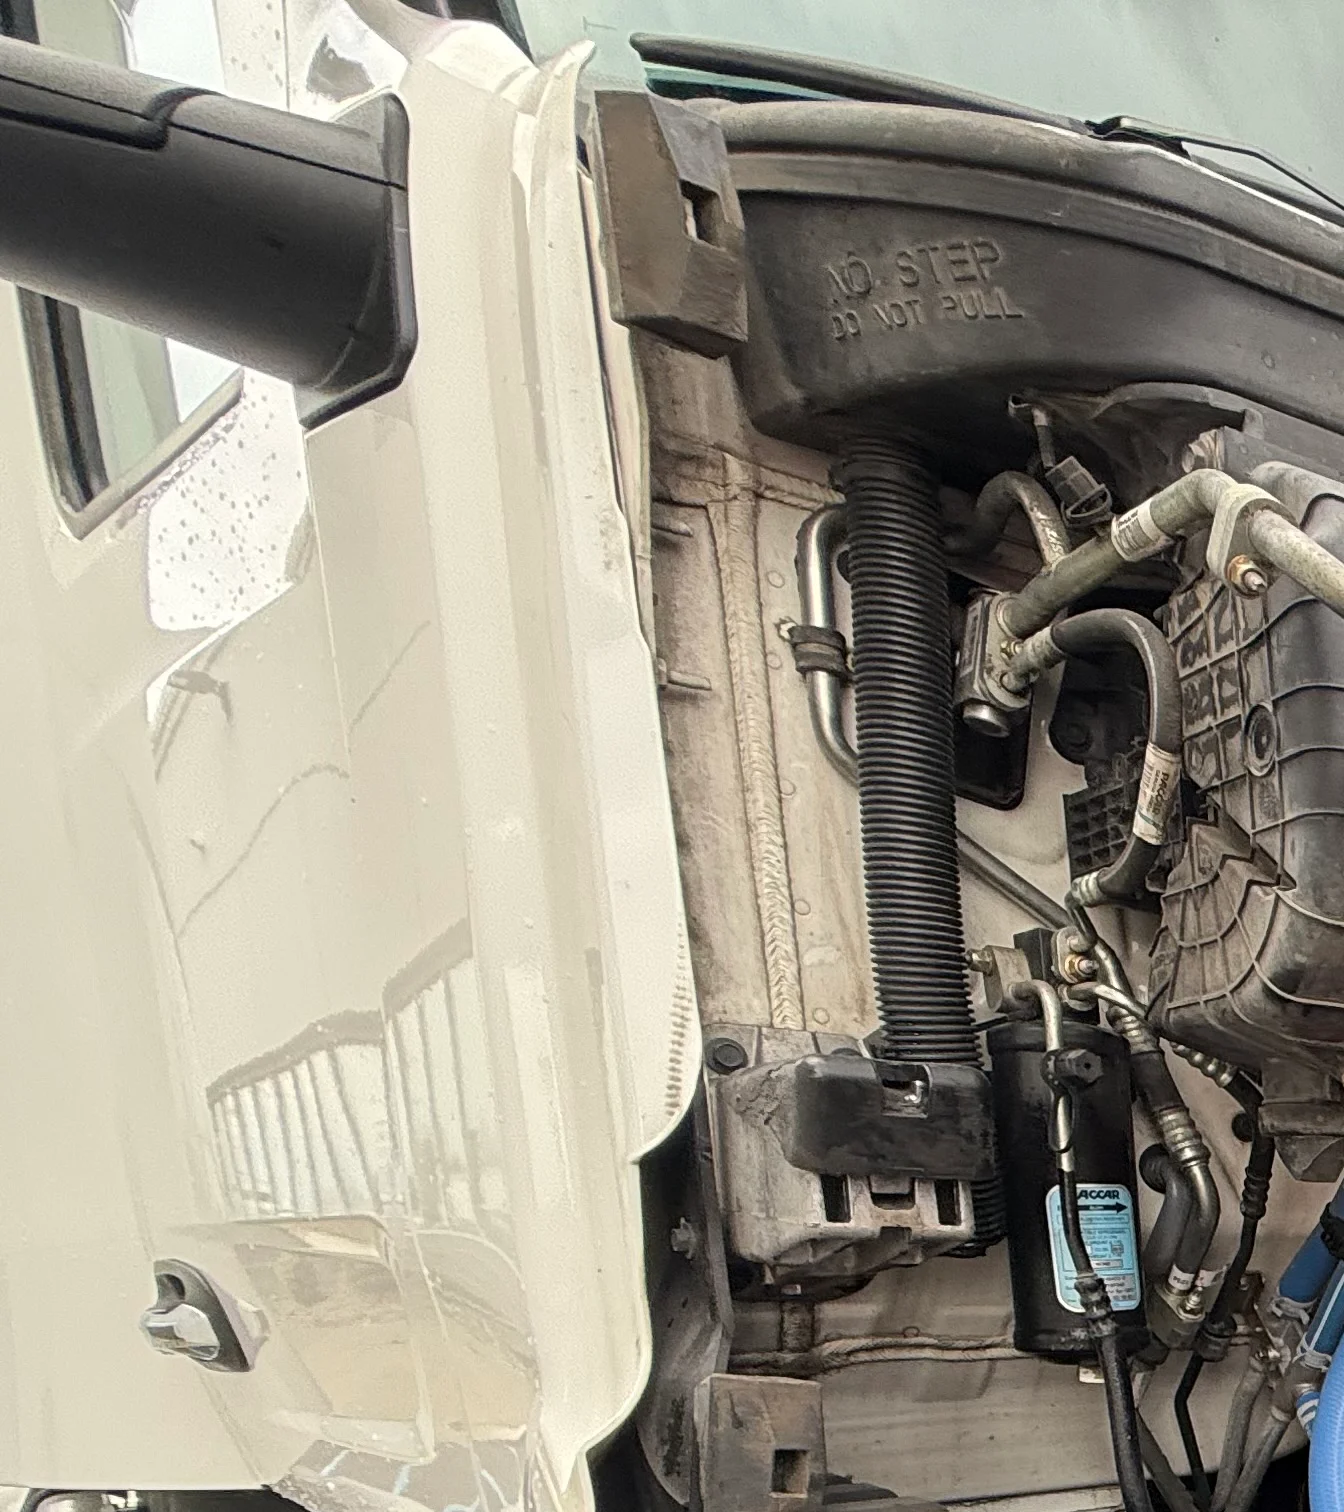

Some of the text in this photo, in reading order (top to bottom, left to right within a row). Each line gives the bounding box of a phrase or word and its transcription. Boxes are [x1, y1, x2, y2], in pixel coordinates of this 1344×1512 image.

[896, 237, 1003, 288] STEP
[831, 287, 1025, 340] DO NOT PULL
